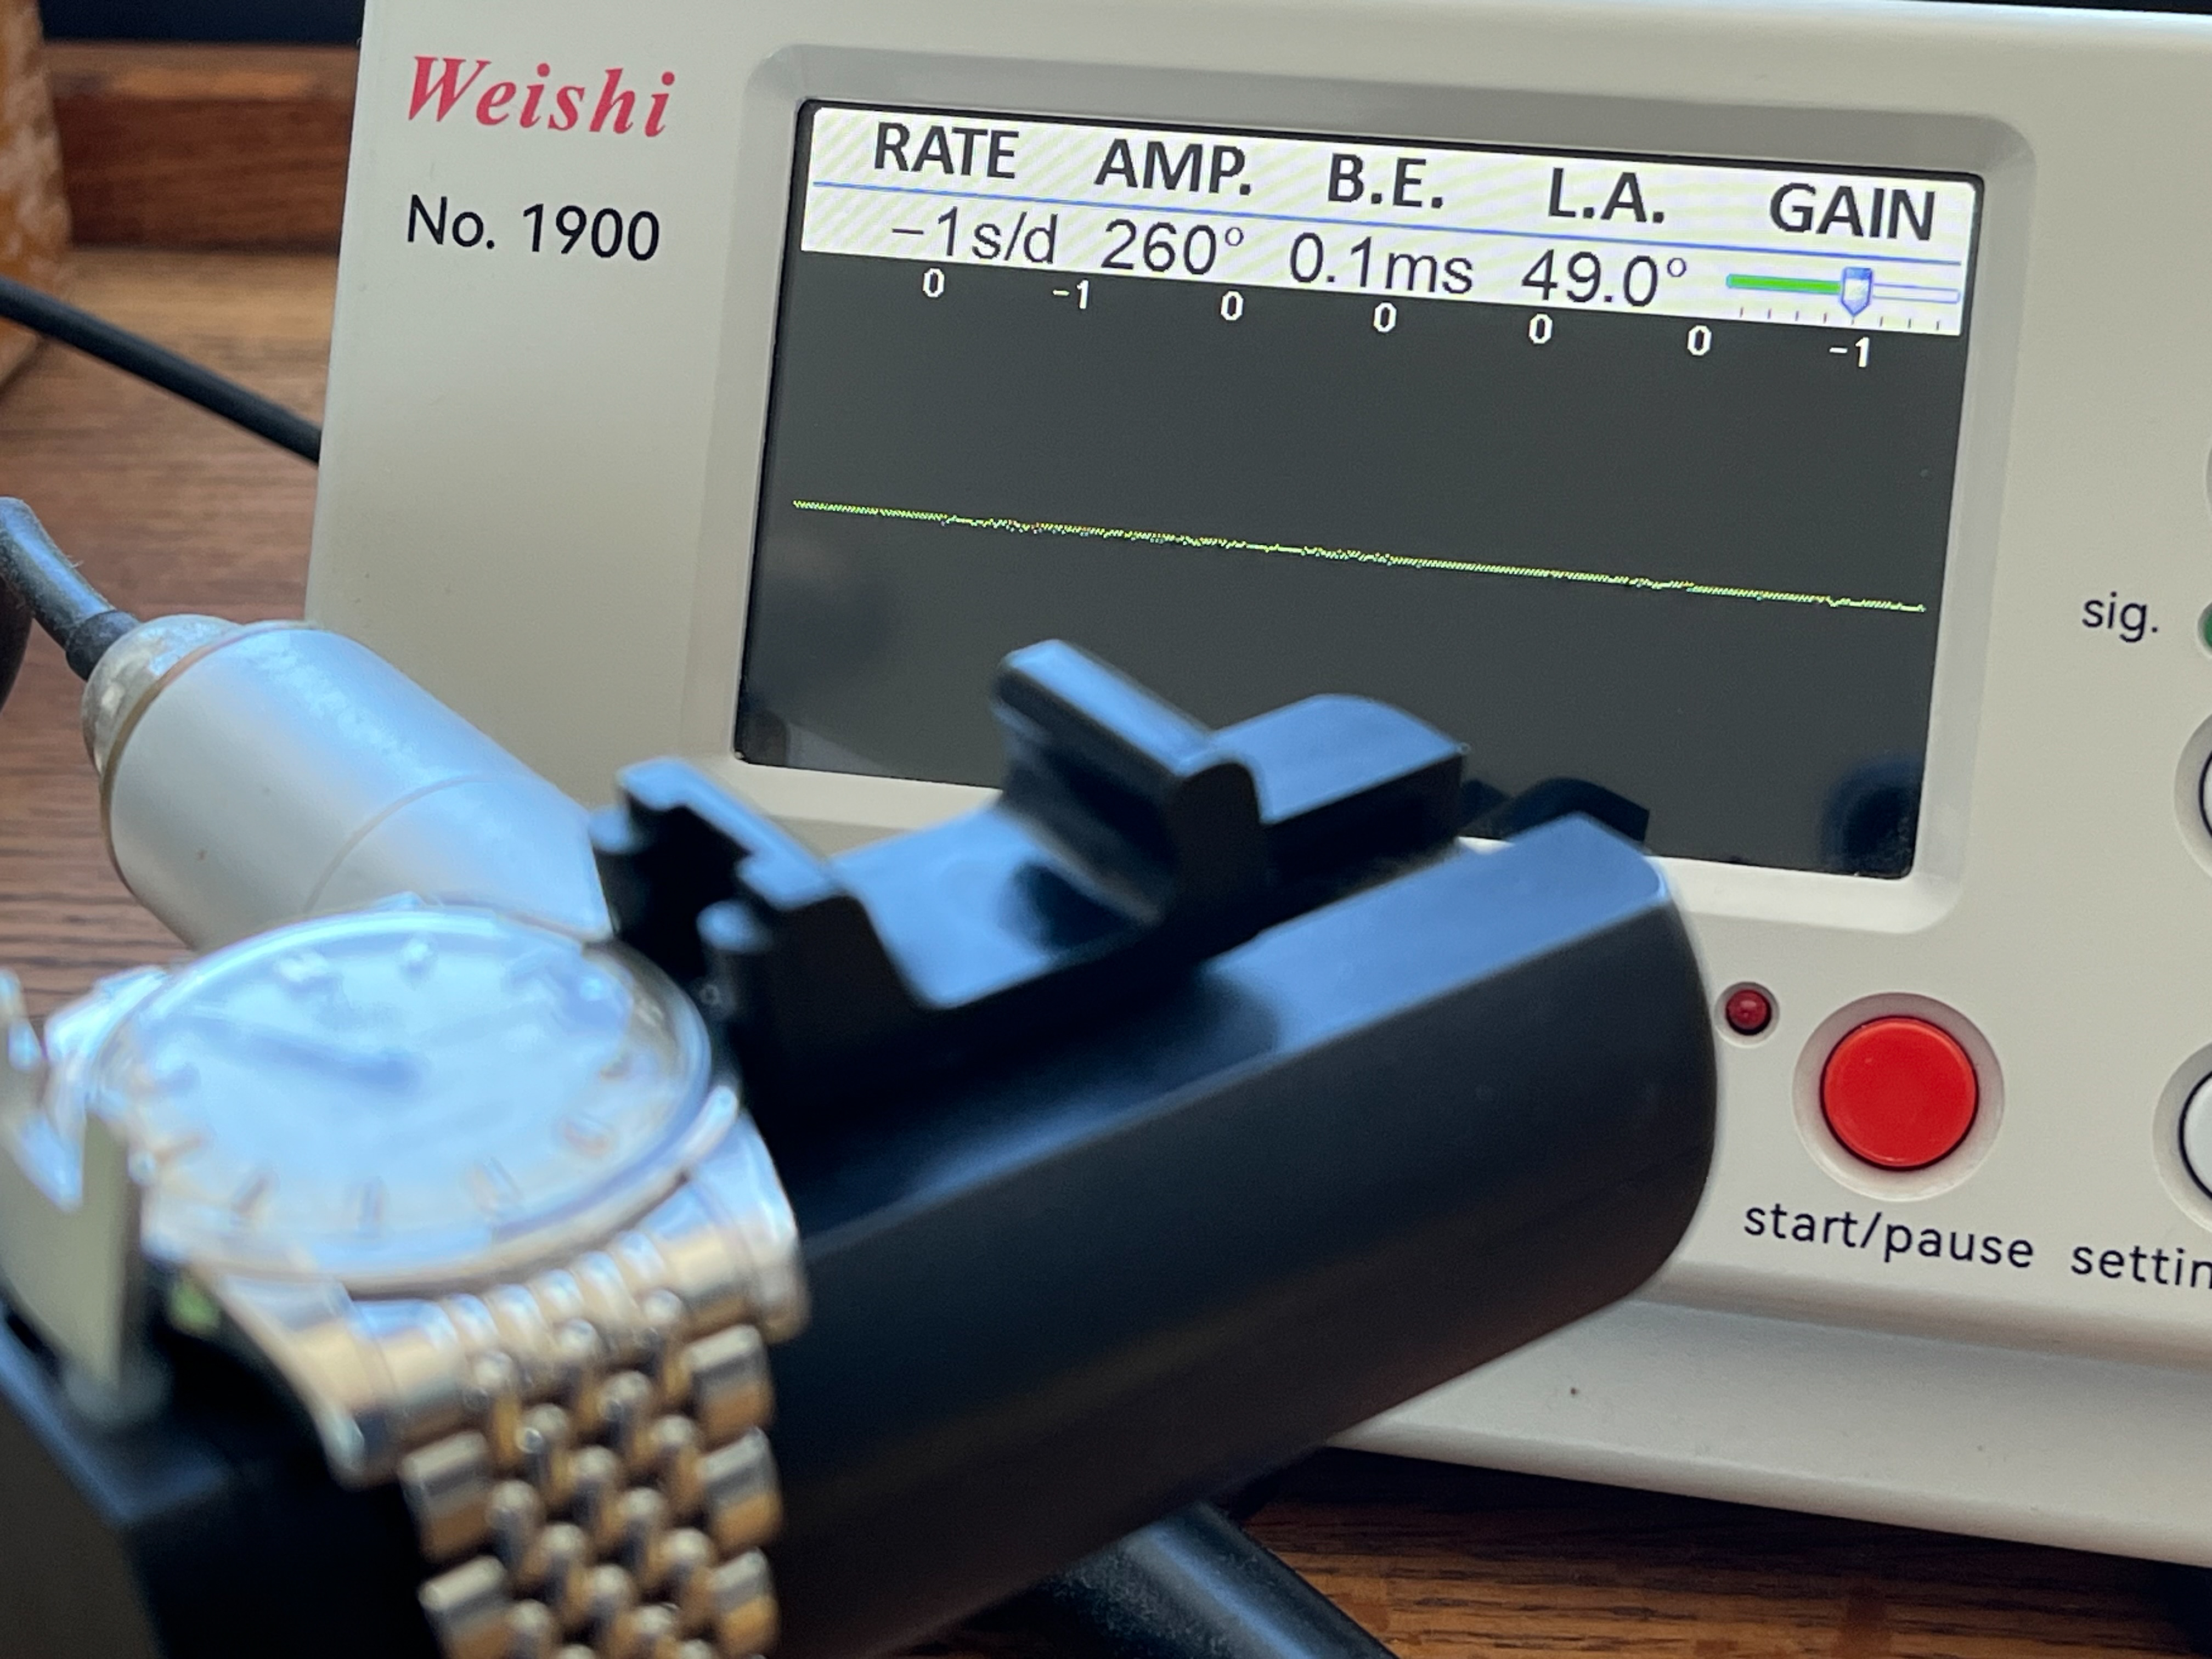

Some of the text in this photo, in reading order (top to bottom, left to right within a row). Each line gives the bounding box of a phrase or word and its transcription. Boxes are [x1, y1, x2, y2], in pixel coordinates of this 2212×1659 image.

[408, 55, 675, 137] Weishi
[873, 122, 1936, 240] RATE AMP. B.E. L.A. GAIN
[407, 194, 660, 261] No. 1900
[1101, 218, 1244, 275] 260°
[1289, 232, 1474, 295] 0.1ms
[1521, 249, 1688, 307] 49.0°
[922, 268, 945, 298] 0
[1221, 291, 1244, 321] 0
[1373, 302, 1396, 333] 0
[1529, 313, 1553, 344] 0
[1688, 324, 1711, 357] 0
[2082, 591, 2158, 643] sig.
[1743, 1204, 2034, 1268] start/pause
